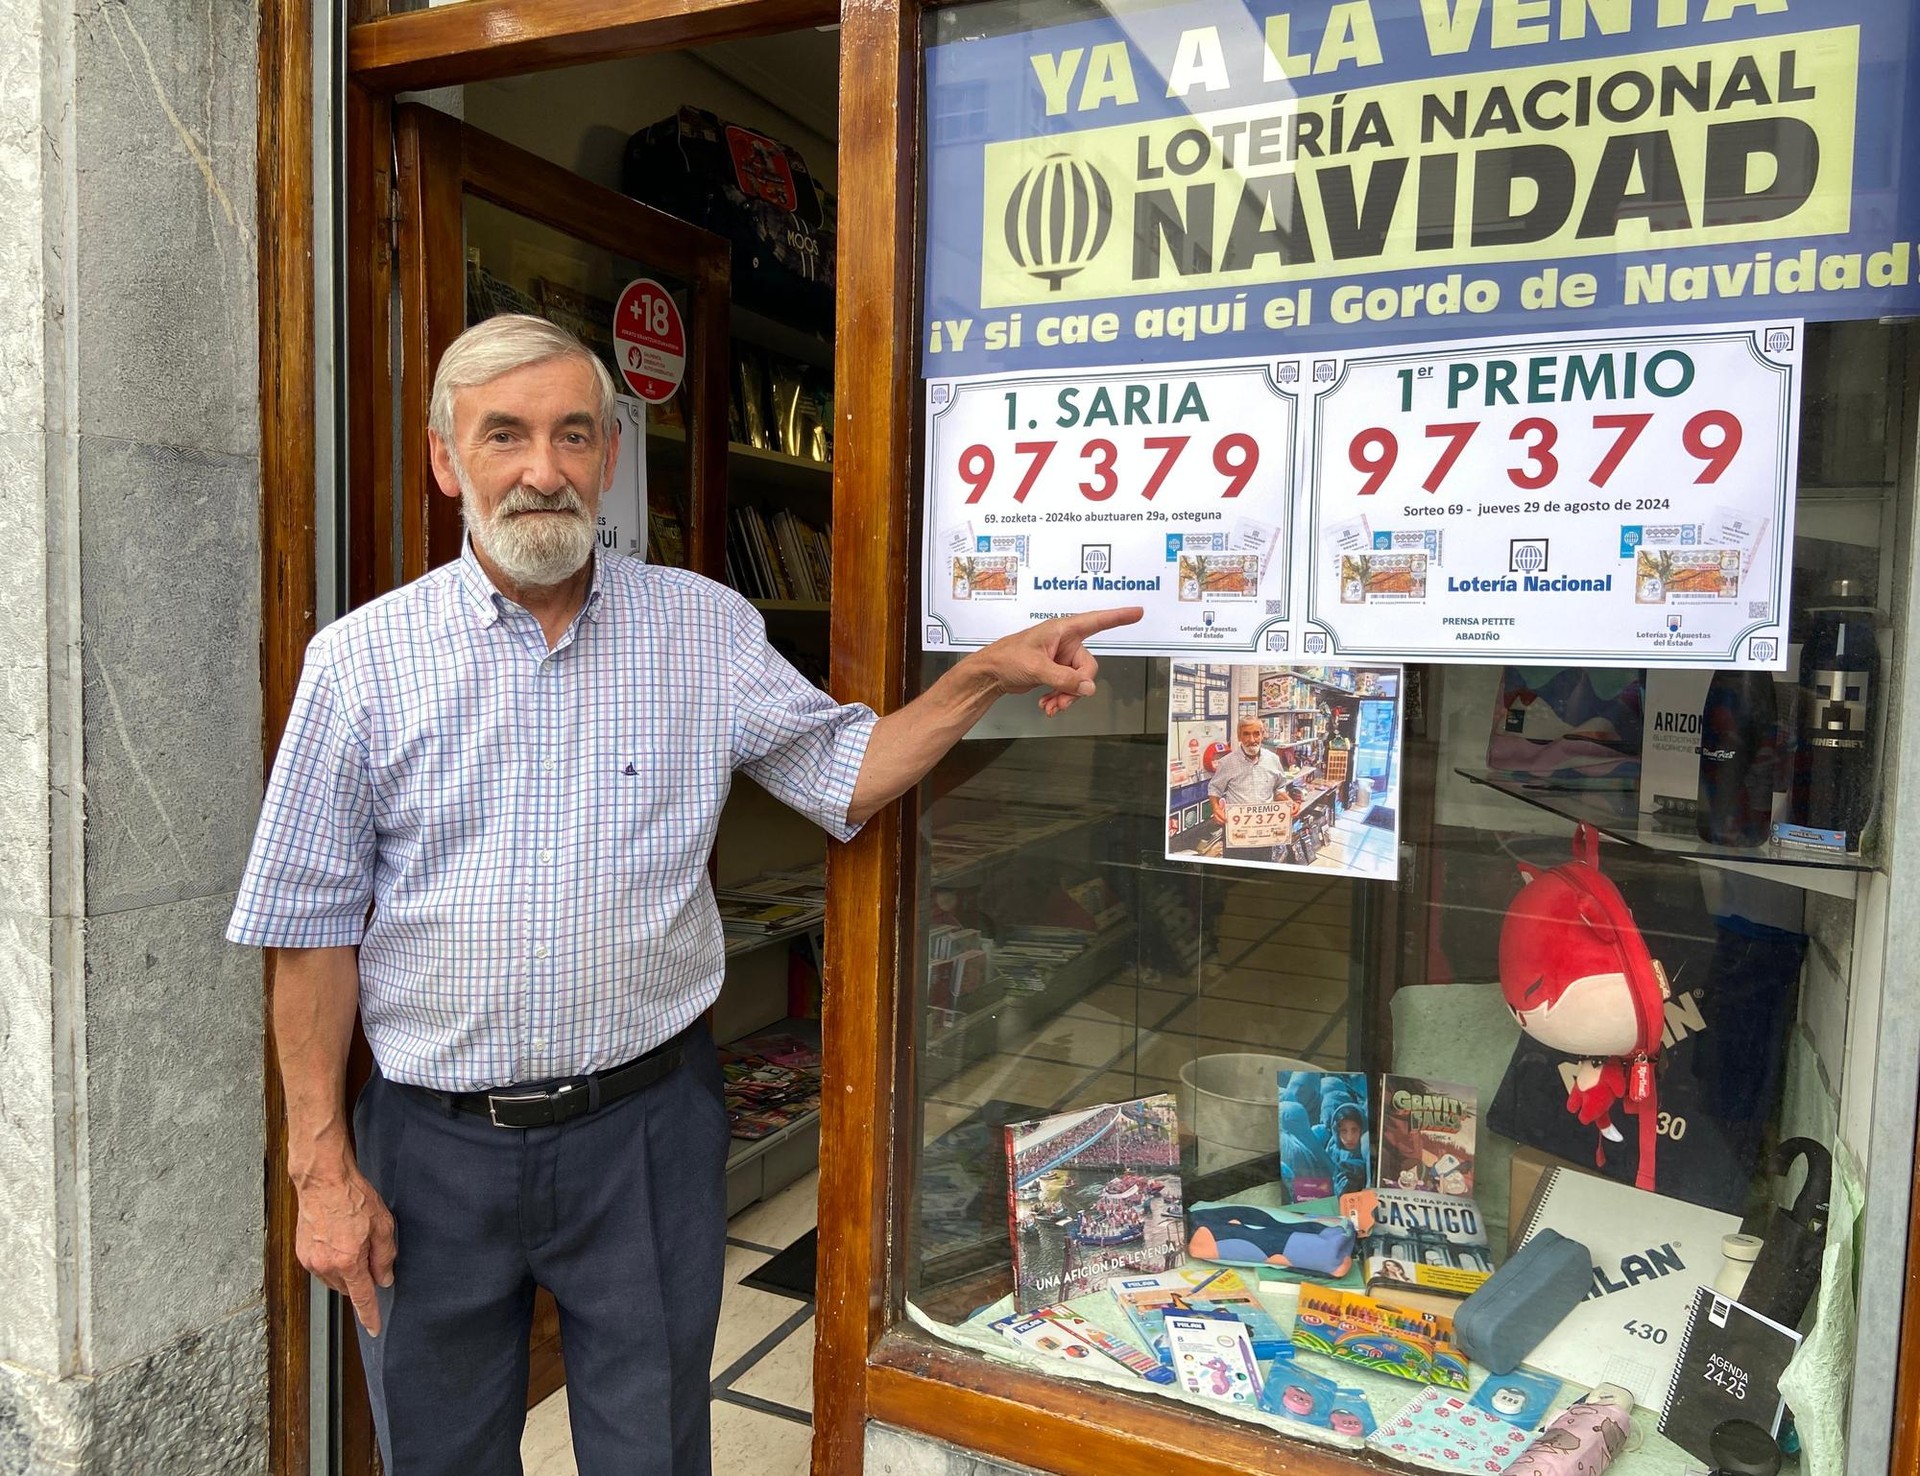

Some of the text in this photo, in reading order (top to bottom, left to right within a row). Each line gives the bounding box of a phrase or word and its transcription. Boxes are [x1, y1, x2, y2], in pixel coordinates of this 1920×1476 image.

[1030, 41, 1139, 117] YA
[1166, 26, 1230, 99] A
[1263, 0, 1383, 82] LA
[1136, 50, 1816, 181] LOTERÍA NACIONAL
[1132, 117, 1820, 281] NAVIDAD
[787, 230, 819, 257] MOOS
[929, 242, 1920, 354] ¡Y si cae aquí el Gordo de Navidad
[630, 294, 669, 336] +18
[1447, 349, 1695, 409] PREMIO
[1004, 382, 1210, 431] 1. SARIA
[1348, 410, 1743, 496] 97379
[958, 433, 1260, 504] 97379
[984, 513, 999, 524] 69.
[1001, 512, 1037, 523] zozketa
[1045, 511, 1082, 523] 2024ko
[1084, 511, 1144, 522] abuztuaren
[1146, 510, 1168, 523] 29a,
[1172, 510, 1222, 524] osteguna
[1403, 506, 1444, 517] Sorteo
[1447, 506, 1463, 516] 69
[1478, 503, 1520, 517] jueves
[1523, 503, 1540, 513] 29
[1544, 501, 1560, 513] de
[1564, 502, 1610, 515] agosto
[1616, 500, 1632, 511] de
[1636, 499, 1670, 510] 2024
[598, 526, 617, 549] UÍ
[1034, 576, 1161, 592] Lotería Nacional
[1448, 575, 1612, 593] Lotería Nacional
[1442, 617, 1478, 626] PRENSA
[1455, 631, 1500, 641] ABADIÑO
[1636, 631, 1667, 639] Loterías
[1675, 632, 1711, 641] Apuestas
[1232, 812, 1287, 826] 97379
[1246, 804, 1281, 814] PREMIO
[1392, 1090, 1468, 1117] GRAVITY
[1372, 1199, 1477, 1235] CASTIGO
[1036, 1274, 1061, 1291] UNA
[1111, 1256, 1126, 1269] DE
[1127, 1280, 1155, 1288] MILAN
[1176, 1321, 1202, 1329] MILAN
[1424, 1313, 1435, 1322] 12
[1177, 1335, 1184, 1343] 8
[1623, 1319, 1668, 1345] 430
[1703, 1363, 1747, 1400] 24-25
[1709, 1353, 1749, 1384] AGENDA
